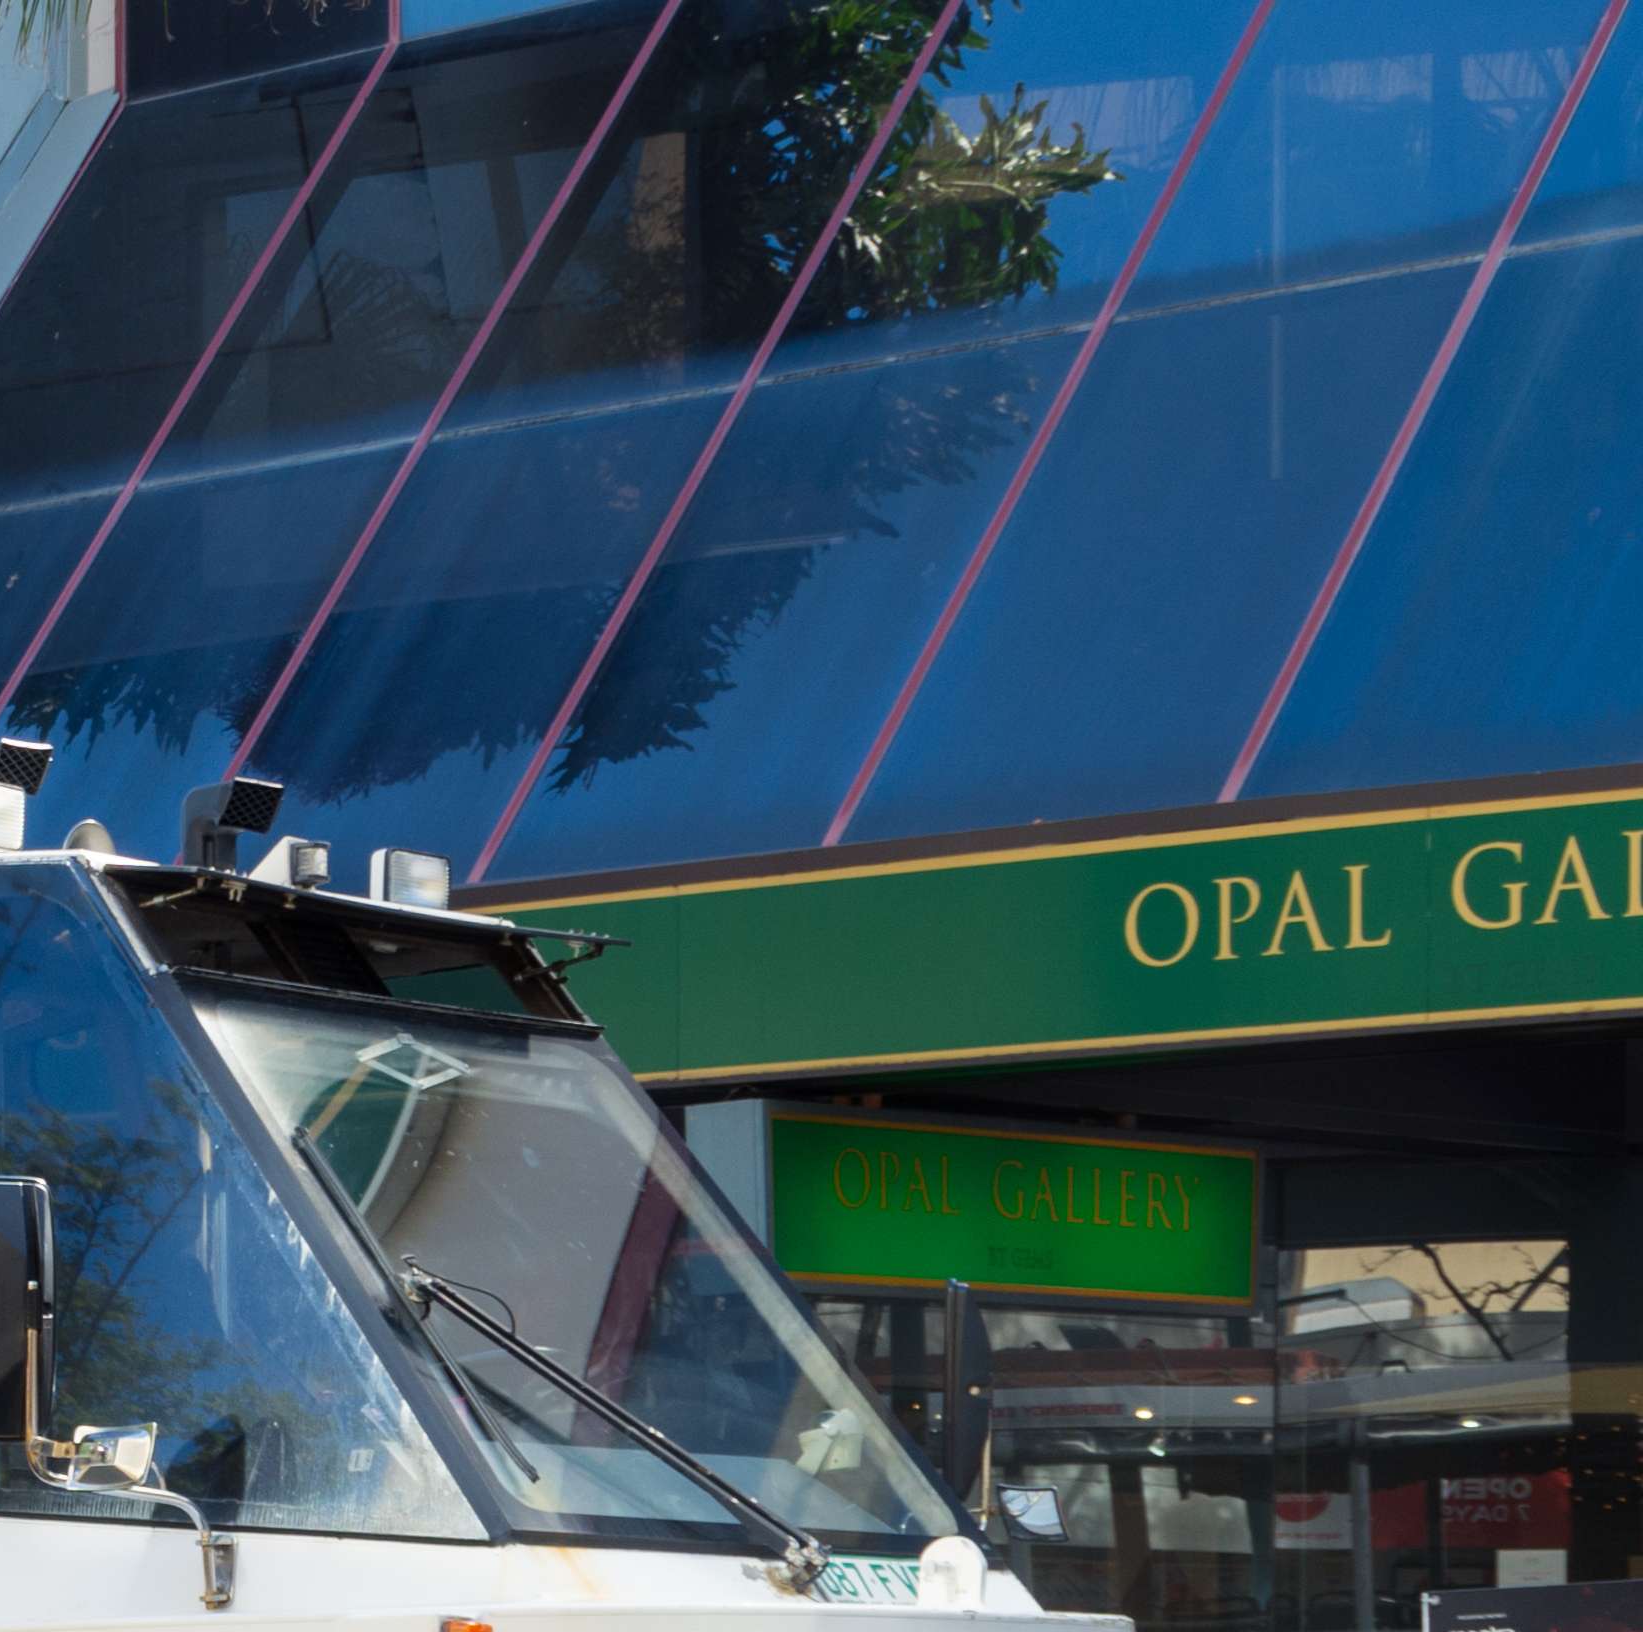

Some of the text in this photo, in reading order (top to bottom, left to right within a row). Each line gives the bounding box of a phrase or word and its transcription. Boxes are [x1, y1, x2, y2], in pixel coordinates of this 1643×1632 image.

[1124, 864, 1393, 968] OPAL
[832, 1147, 1200, 1233] OPAL GALLERY
